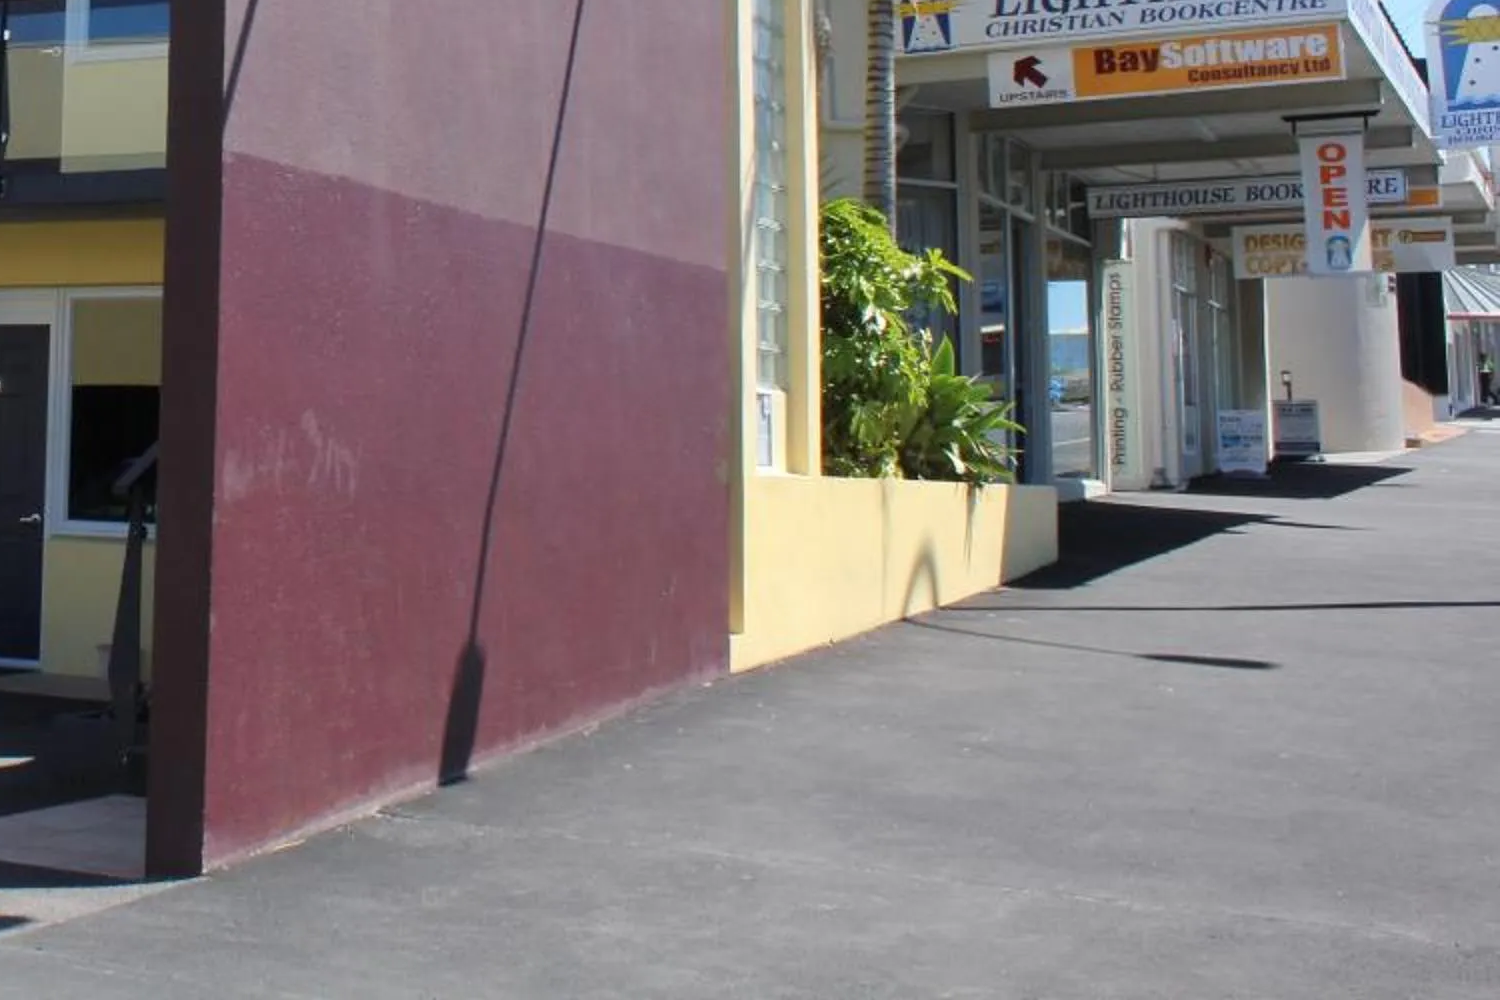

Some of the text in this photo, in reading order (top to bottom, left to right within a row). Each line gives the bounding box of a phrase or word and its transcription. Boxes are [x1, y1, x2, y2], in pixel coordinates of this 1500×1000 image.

[985, 9, 1125, 39] CHRISTIAN
[1187, 57, 1332, 84] Consultancy Ltd
[999, 88, 1069, 102] UPSTAIRS
[1095, 176, 1399, 211] LIGHTHOUSE BOOKRE
[1316, 142, 1351, 231] OPEN
[1243, 232, 1305, 253] DESIG
[1108, 272, 1125, 331] Stamps
[1109, 335, 1125, 392] Rubber
[1111, 406, 1128, 466] Printing
